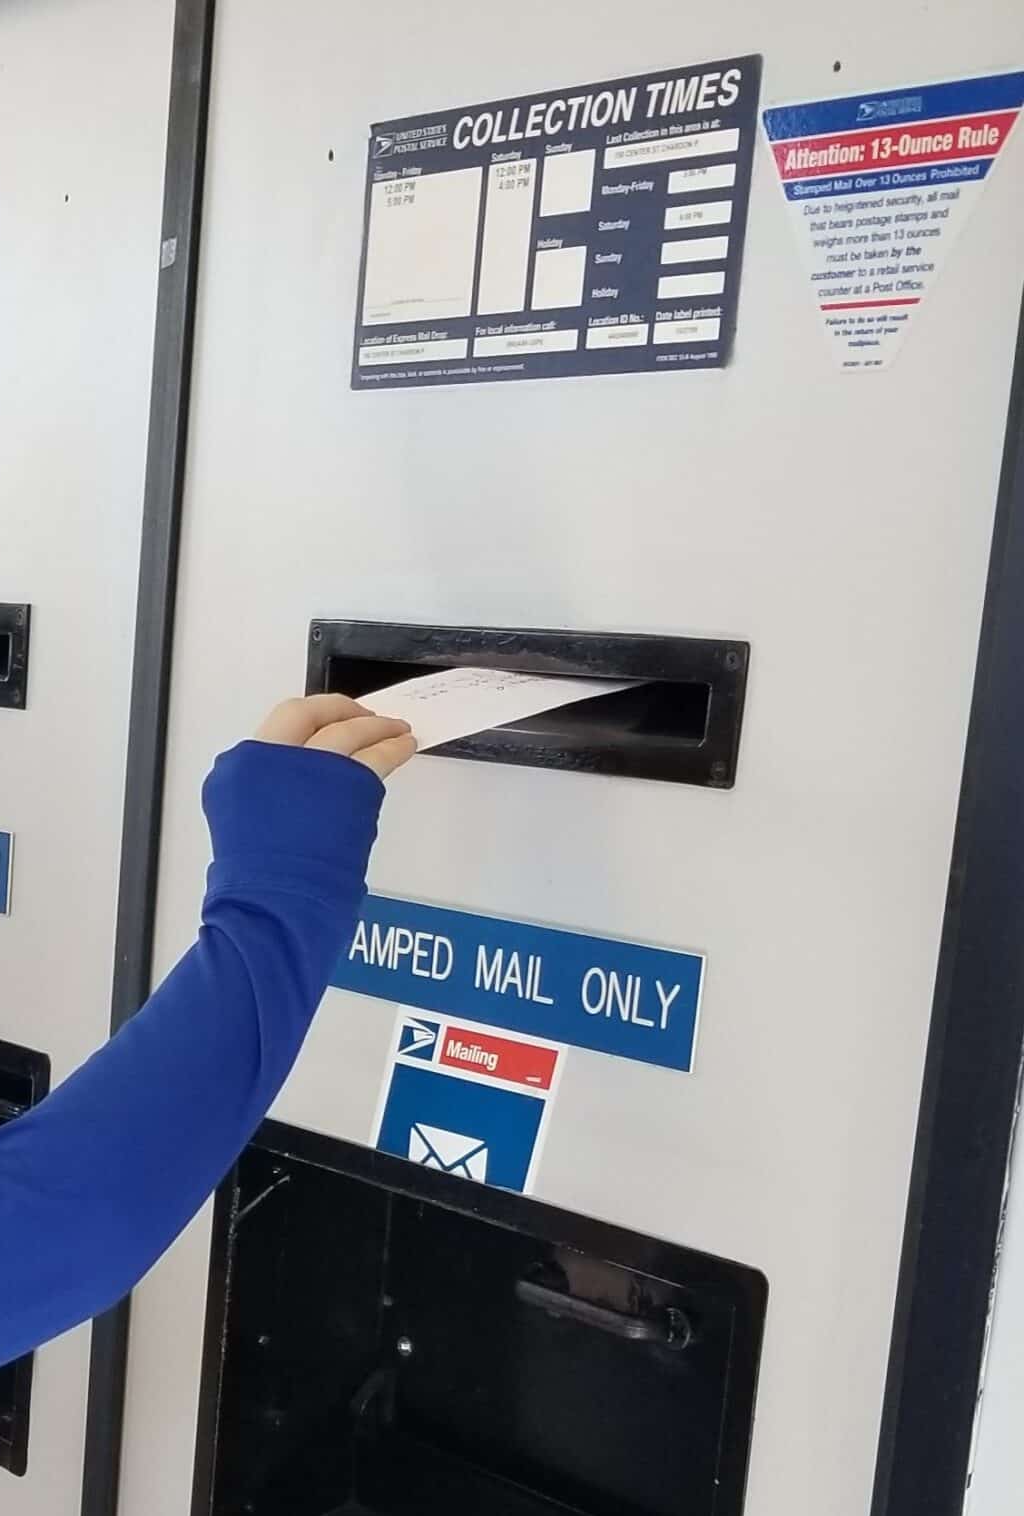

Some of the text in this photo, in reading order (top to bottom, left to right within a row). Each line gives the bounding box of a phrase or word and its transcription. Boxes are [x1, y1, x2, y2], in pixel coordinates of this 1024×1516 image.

[453, 69, 742, 150] COLLECTION TIMES
[606, 134, 622, 145] Last
[623, 129, 659, 142] Collection
[545, 143, 573, 154] Sunday
[785, 124, 1000, 170] Attention: 13-Ounce Rule
[491, 151, 522, 162] Saturday
[793, 164, 980, 197] Stamped Mail Over 13 Ounces Prohibited
[803, 204, 820, 216] Due
[823, 204, 832, 213] to
[834, 198, 884, 213] heightened
[927, 191, 938, 202] all
[939, 188, 960, 200] mail
[598, 219, 631, 232] Saturday
[810, 207, 950, 232] that bears postage stamps and
[537, 238, 564, 249] Holiday
[813, 227, 941, 249] weighs more than 13 ounces
[594, 253, 623, 265] Sunday
[826, 245, 922, 263] must be taken by the
[810, 267, 856, 281] customer
[857, 266, 867, 277] to
[876, 263, 899, 275] retail
[901, 262, 935, 273] service
[591, 288, 619, 299] Holiday
[818, 284, 851, 297] counter
[853, 283, 863, 294] at
[872, 281, 894, 293] Post
[588, 316, 619, 326] Location
[656, 311, 673, 321] Date
[673, 308, 692, 320] label
[348, 920, 681, 1030] AMPED MAIL ONLY
[445, 1039, 499, 1071] Mailing
